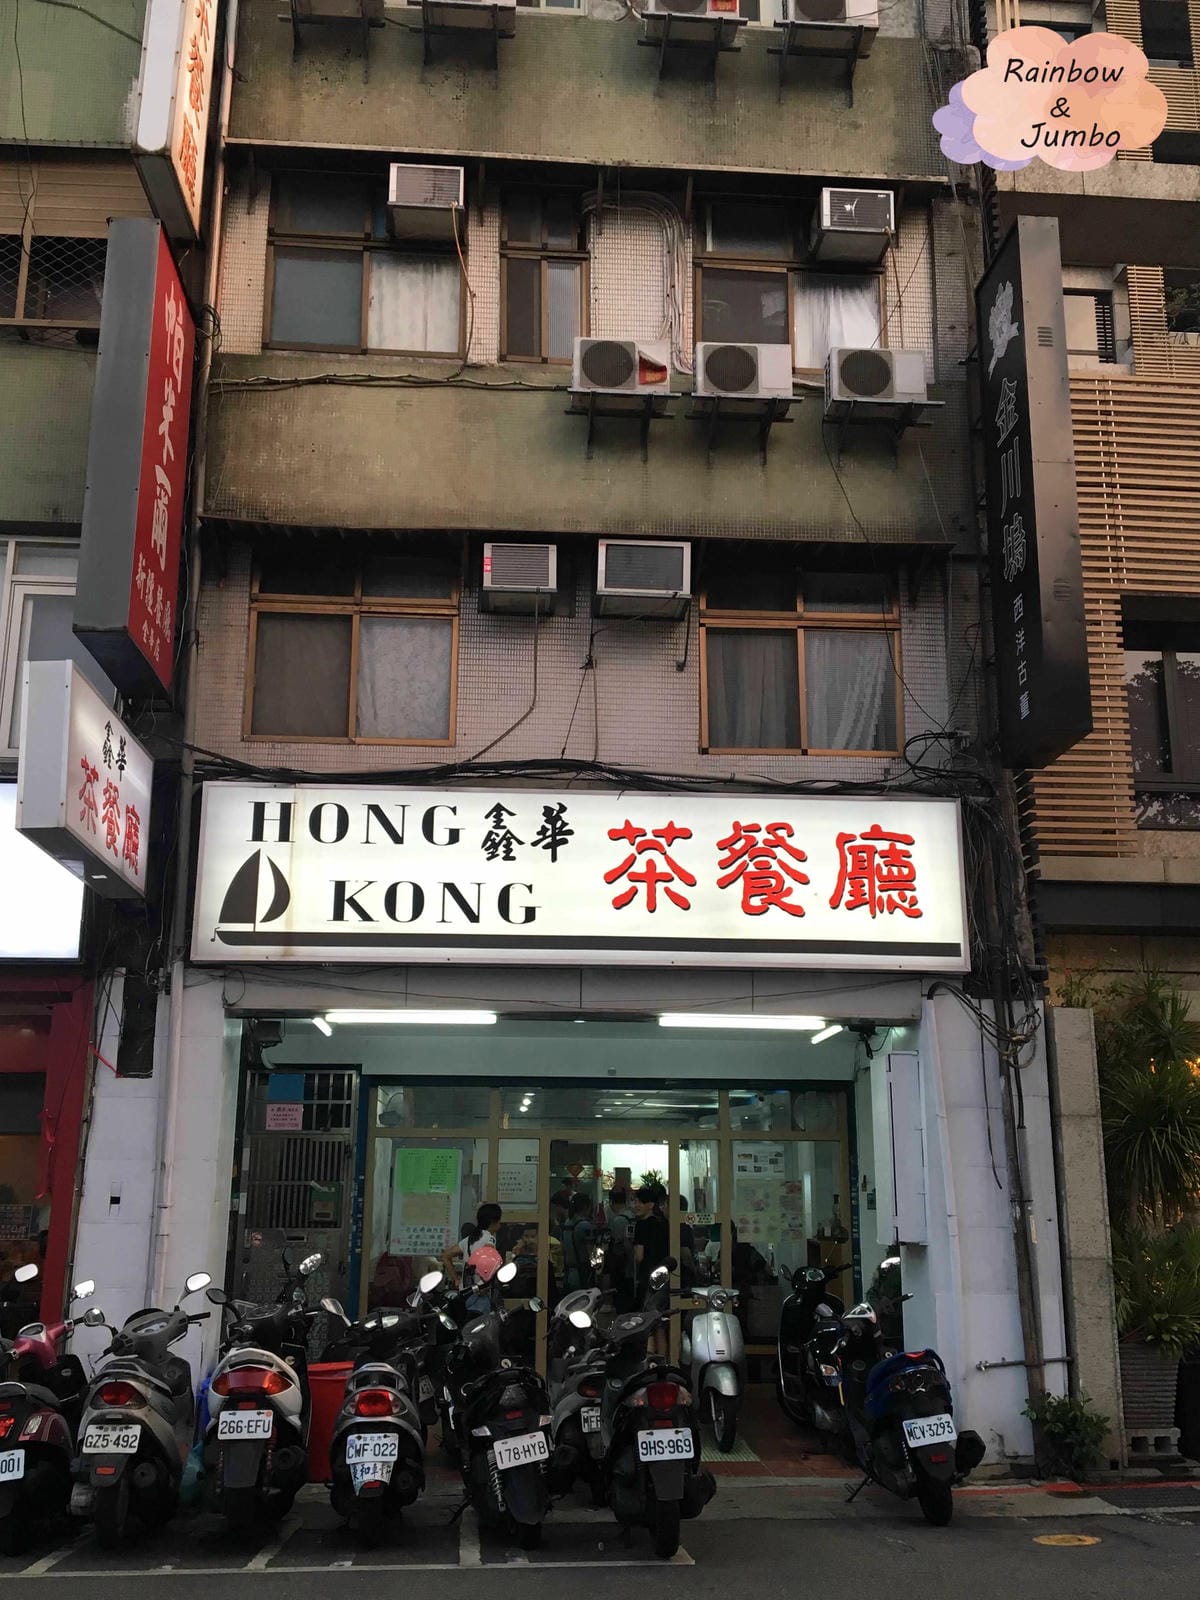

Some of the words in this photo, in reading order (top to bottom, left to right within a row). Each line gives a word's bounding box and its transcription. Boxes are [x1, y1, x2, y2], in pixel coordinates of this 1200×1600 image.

[102, 720, 127, 782] 鑫華
[78, 753, 141, 876] 茶餐廳
[246, 801, 466, 847] HONG
[480, 802, 575, 863] 鑫華
[603, 818, 923, 919] 茶餐廳
[326, 879, 543, 925] KONG
